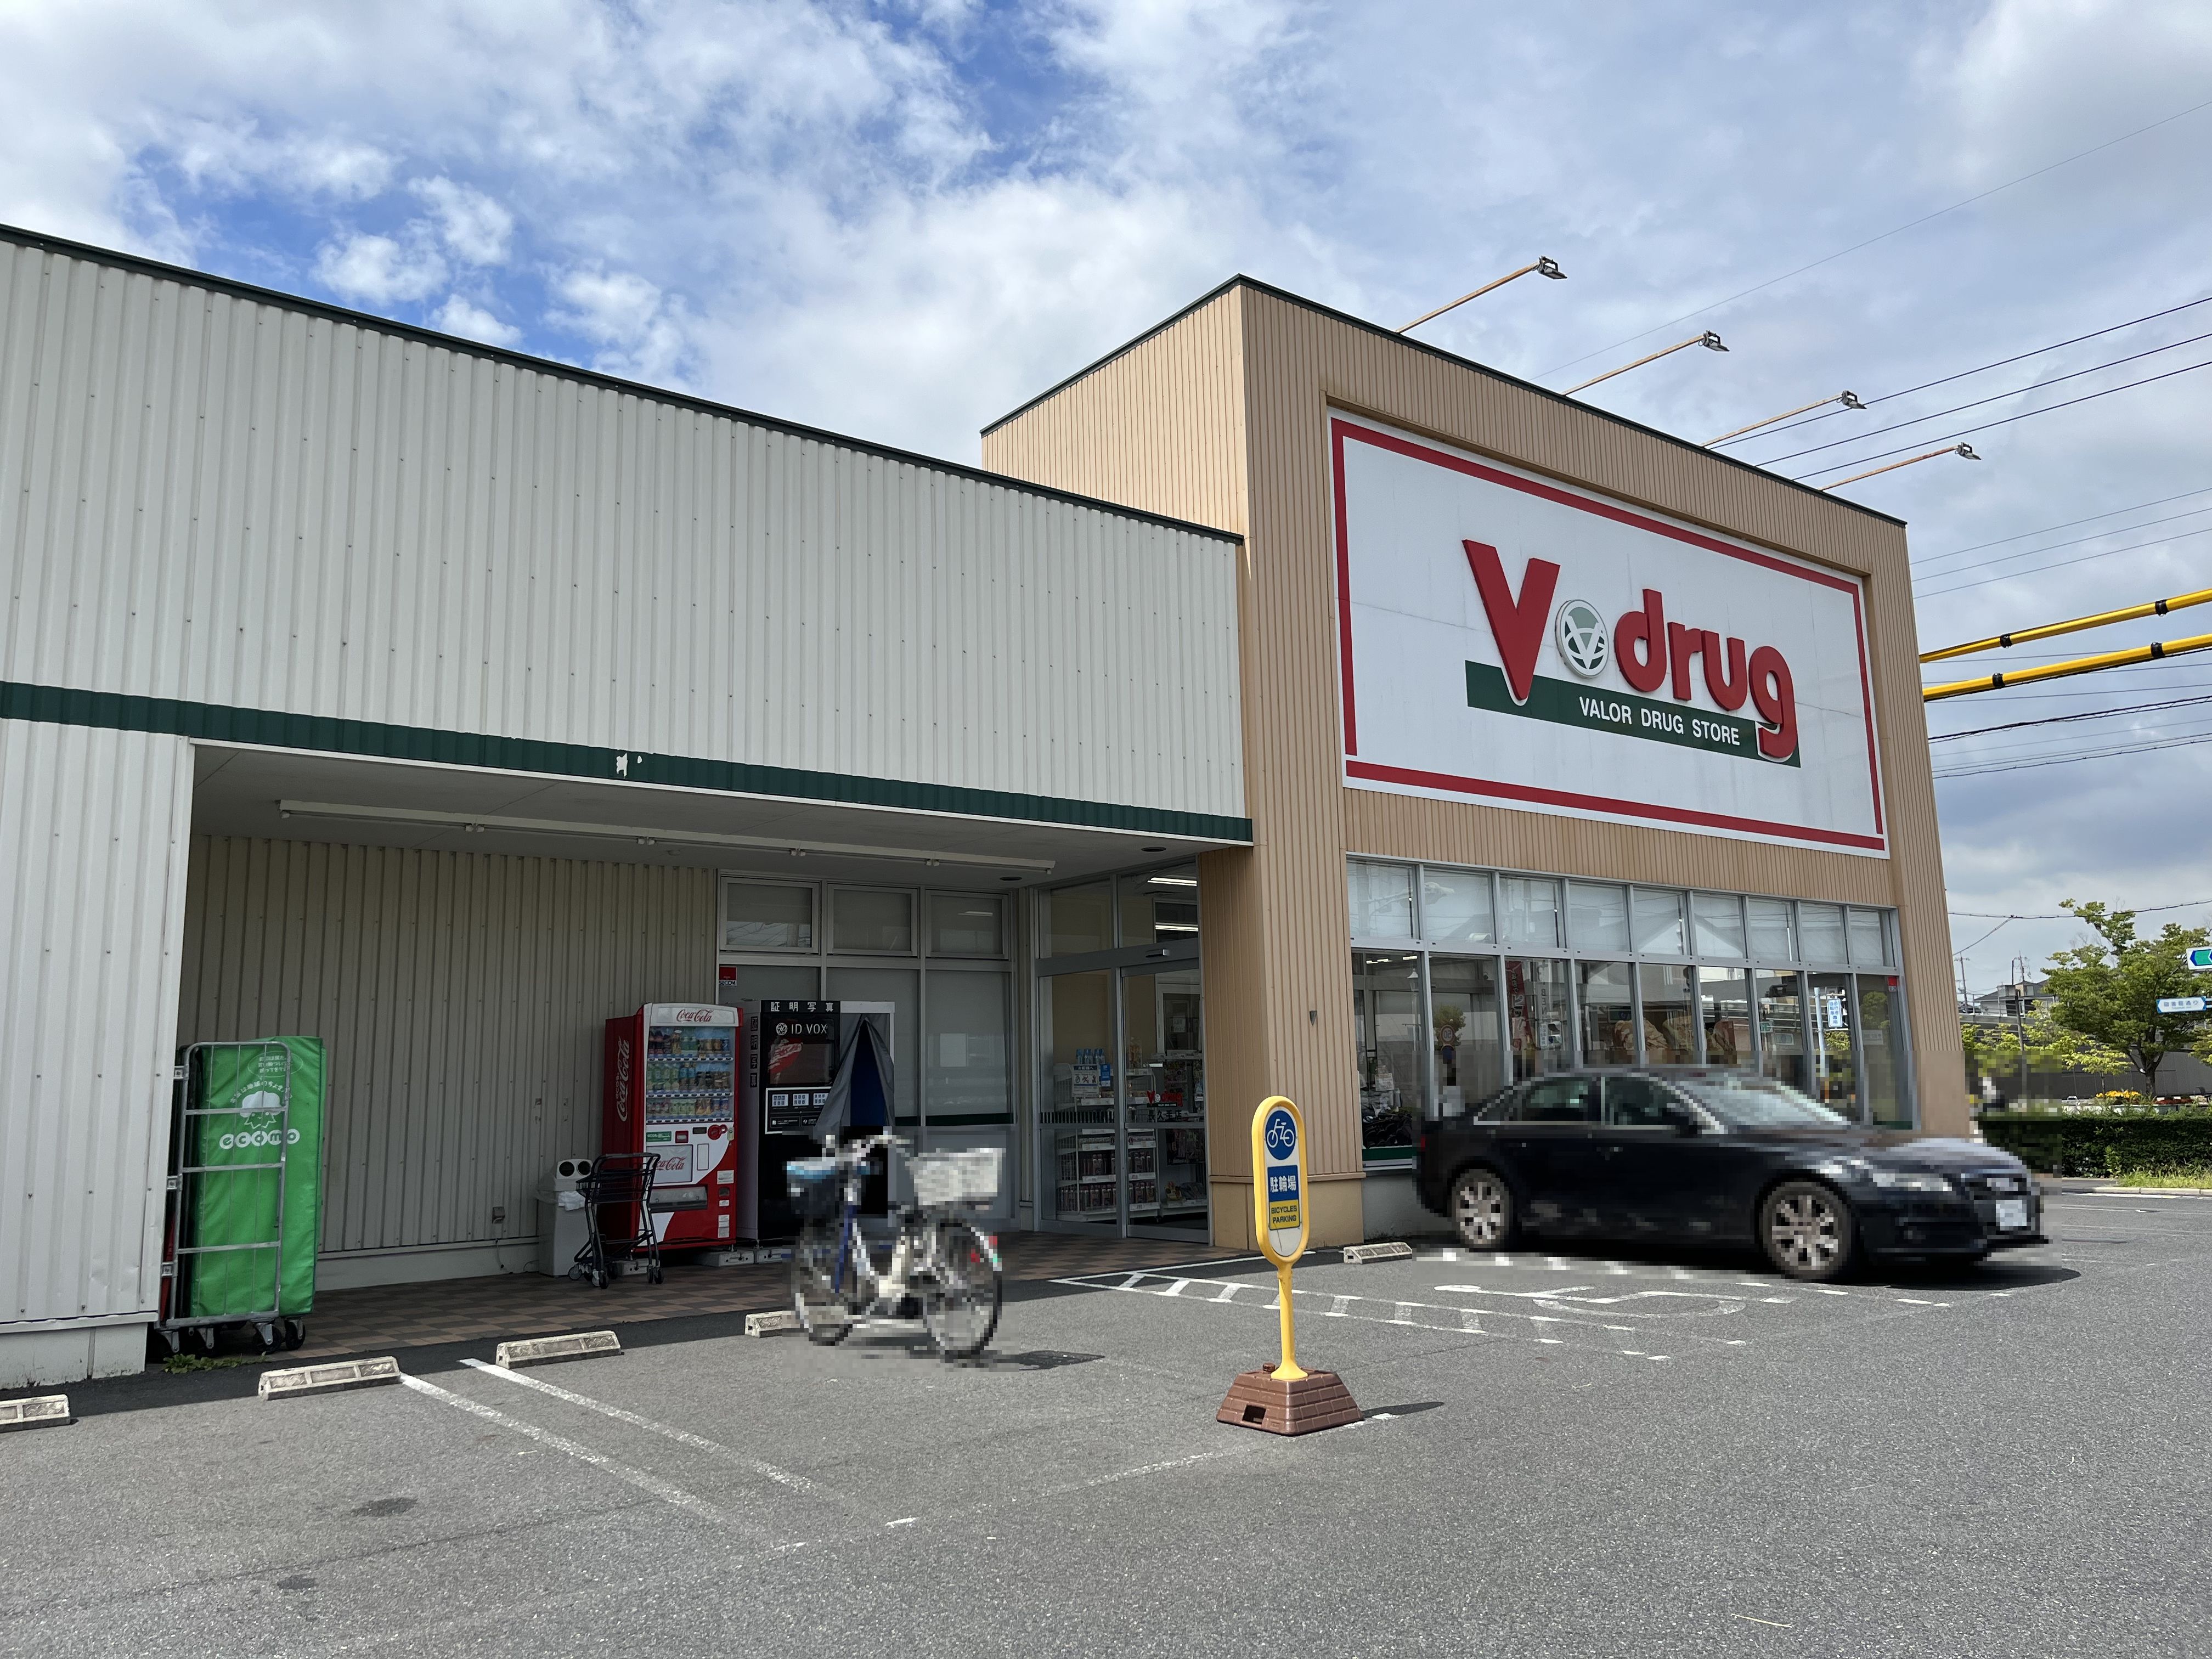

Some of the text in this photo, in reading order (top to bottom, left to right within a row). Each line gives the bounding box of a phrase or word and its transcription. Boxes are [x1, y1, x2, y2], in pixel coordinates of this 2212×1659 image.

[1579, 696, 1740, 746] VALOR DRUG STORE
[770, 1002, 834, 1012] 証明写真
[676, 1009, 714, 1023] Coca-Cola
[792, 1024, 827, 1035] ID VOX
[617, 1036, 630, 1122] Coca-Cola
[1269, 1175, 1297, 1193] 駐輪場
[1271, 1205, 1297, 1214] BICYCLES
[1272, 1215, 1297, 1223] PARKING
